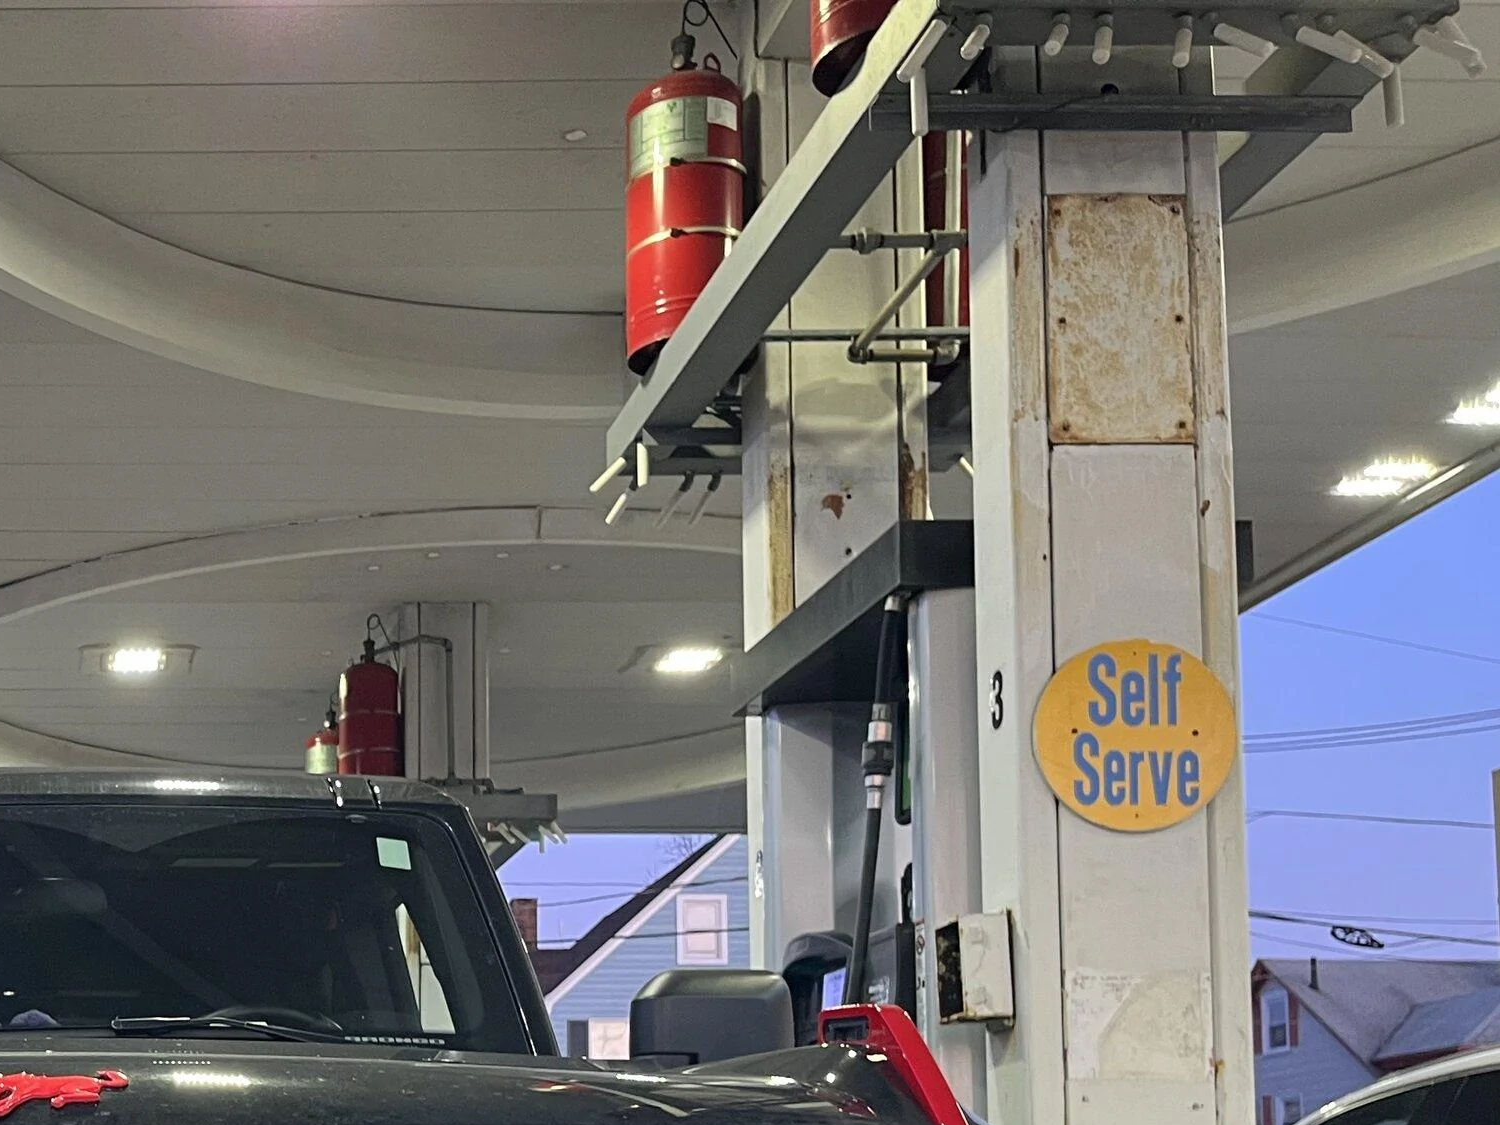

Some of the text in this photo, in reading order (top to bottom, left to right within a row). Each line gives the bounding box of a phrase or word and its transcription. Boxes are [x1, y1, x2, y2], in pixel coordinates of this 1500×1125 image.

[989, 670, 1003, 730] 3
[1088, 653, 1182, 727] Self
[1073, 732, 1200, 806] Serve
